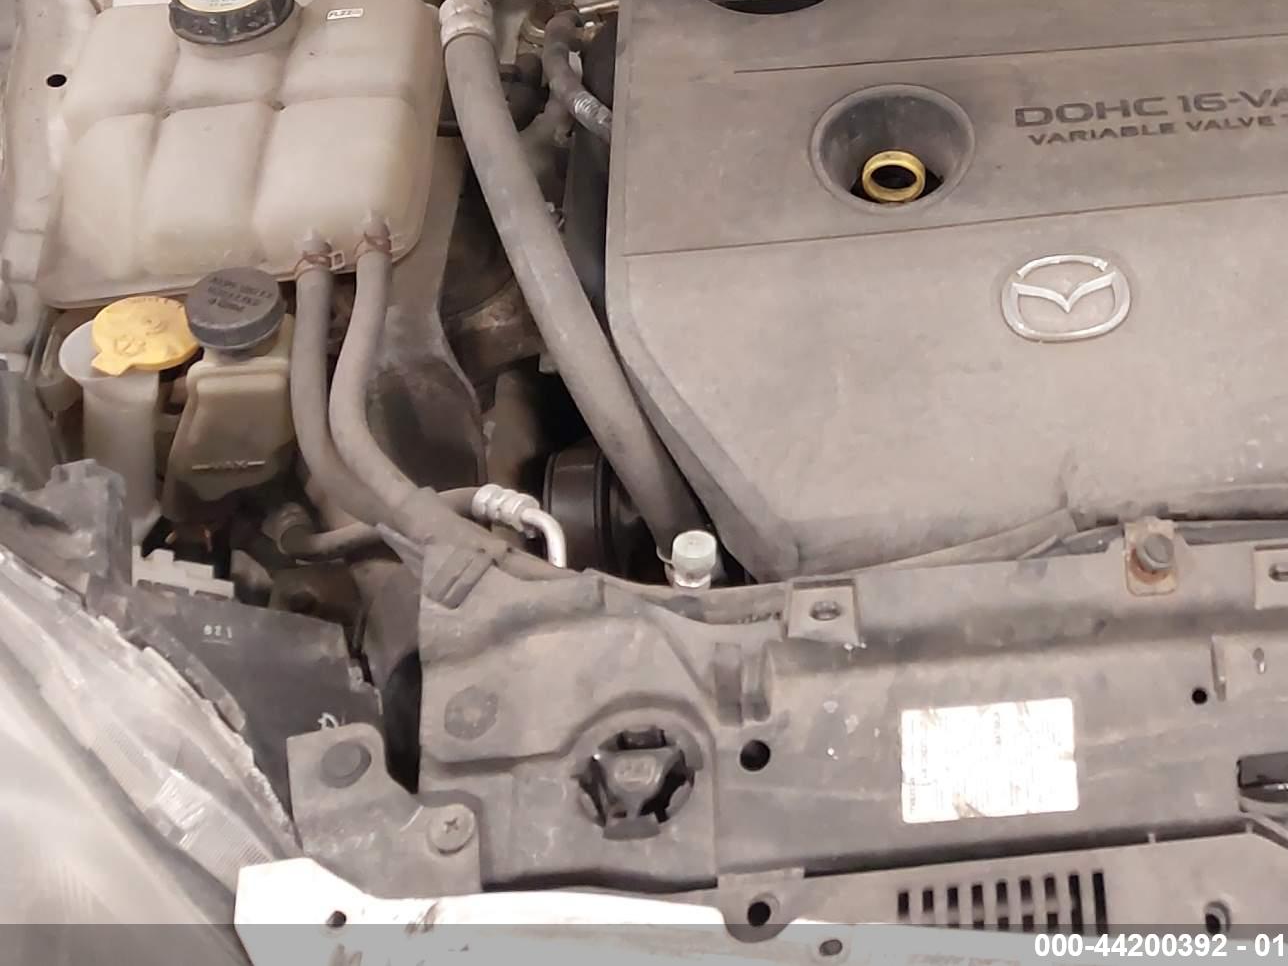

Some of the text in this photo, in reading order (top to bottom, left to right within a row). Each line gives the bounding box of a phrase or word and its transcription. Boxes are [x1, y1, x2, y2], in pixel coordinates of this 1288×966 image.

[1015, 97, 1169, 127] DOHC
[1028, 122, 1175, 146] VARIABLE
[1185, 115, 1276, 132] VALVE
